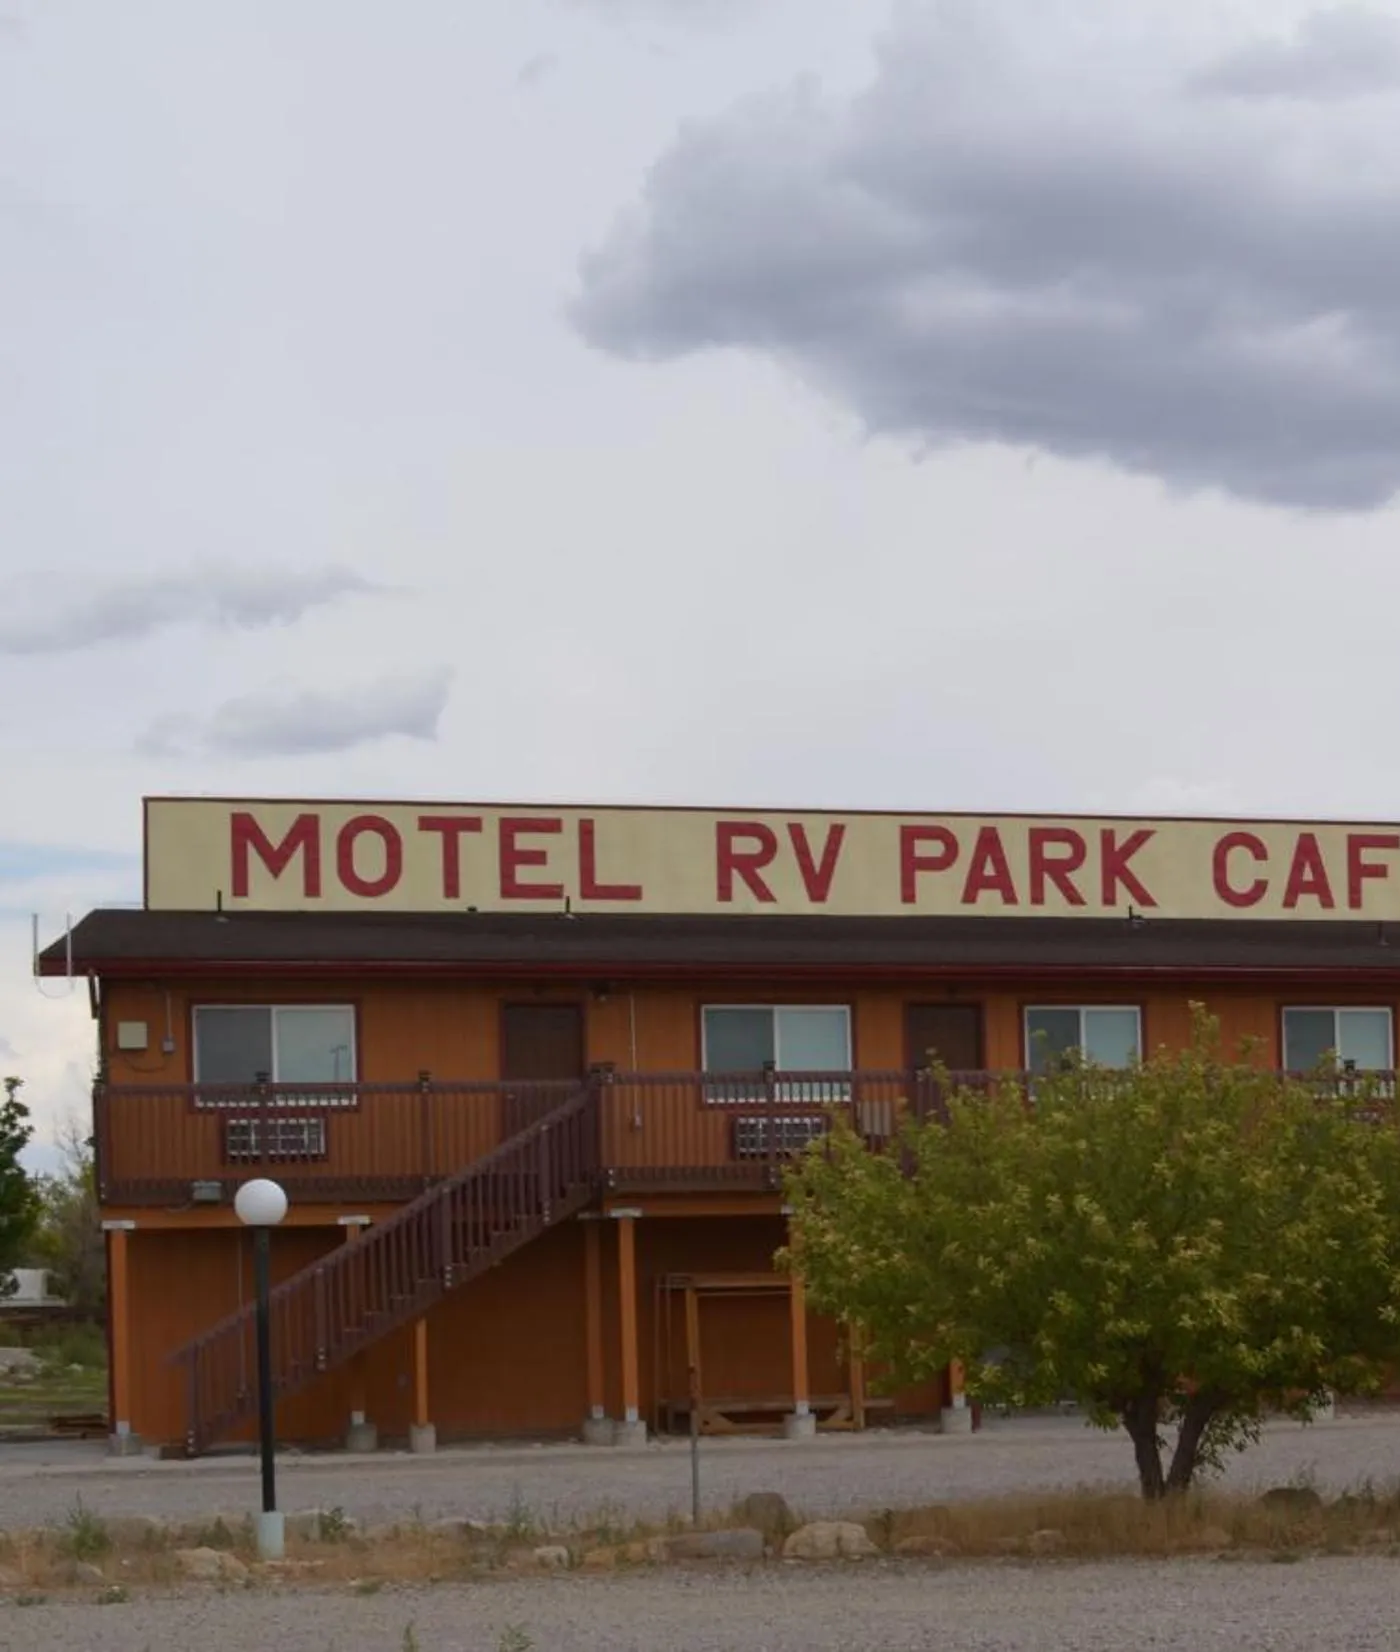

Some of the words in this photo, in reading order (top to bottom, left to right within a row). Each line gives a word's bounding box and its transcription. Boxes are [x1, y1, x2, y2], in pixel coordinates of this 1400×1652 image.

[230, 812, 642, 900] MOTEL
[715, 823, 846, 902] RV
[900, 824, 1158, 907] PARK
